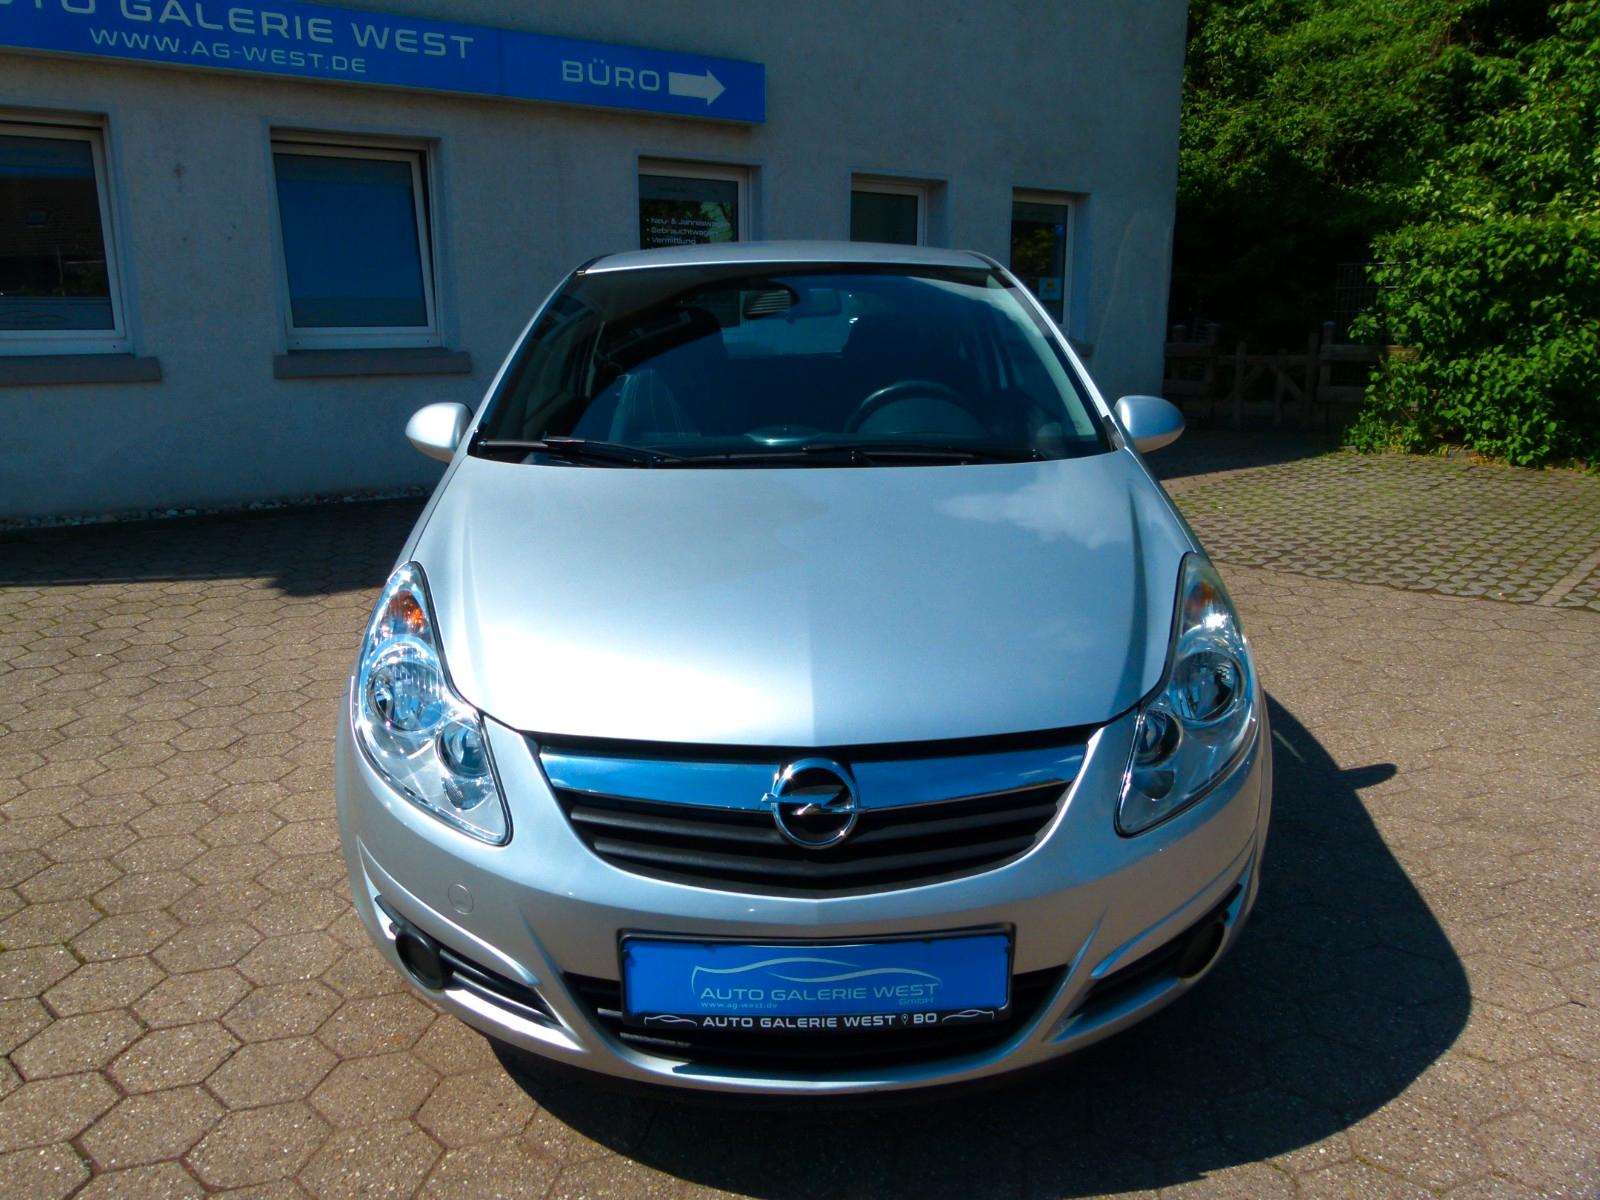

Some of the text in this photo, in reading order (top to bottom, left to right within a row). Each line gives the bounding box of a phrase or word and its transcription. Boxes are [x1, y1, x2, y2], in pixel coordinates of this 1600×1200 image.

[119, 0, 475, 59] GALERIE WEST
[89, 27, 367, 73] WWW.AG-WEST.DE
[561, 58, 660, 92] BÜRO
[700, 983, 940, 1001] AUTO GALERIE WEST
[700, 1001, 779, 1010] www.ag-west.de
[703, 1012, 938, 1029] AUTO GALERIE WEST BO
